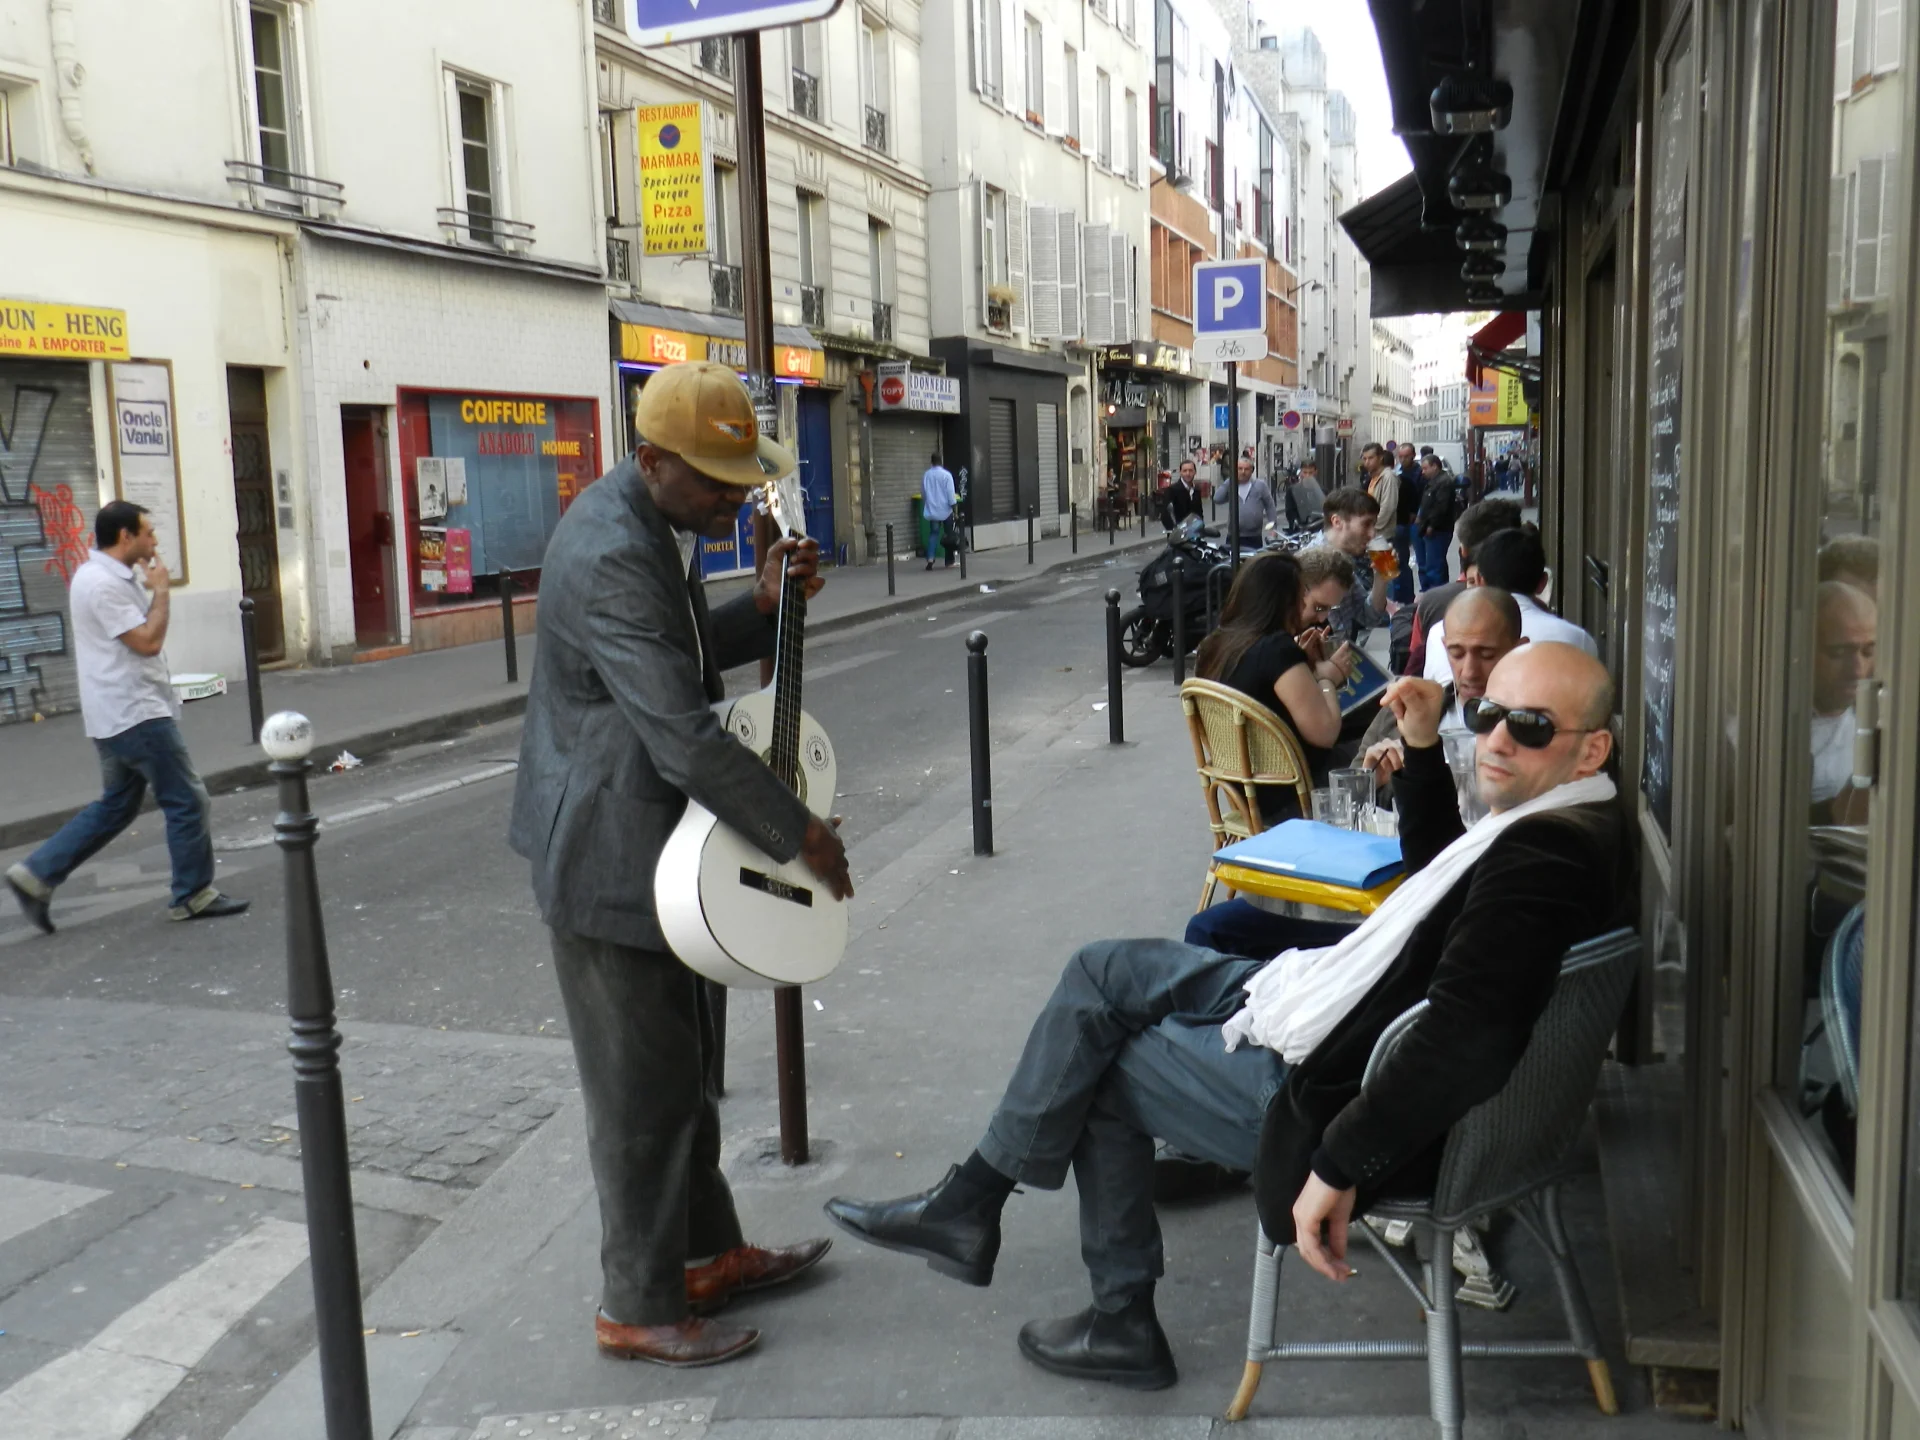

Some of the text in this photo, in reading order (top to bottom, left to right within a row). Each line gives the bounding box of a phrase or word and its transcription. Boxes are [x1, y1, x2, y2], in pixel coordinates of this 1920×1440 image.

[640, 104, 698, 122] RESTAURANT
[640, 152, 700, 170] MARMARA
[655, 189, 689, 202] turque
[653, 204, 692, 218] Pizza
[645, 222, 704, 236] Grillade au
[667, 238, 679, 250] de
[683, 236, 704, 249] bois
[1214, 276, 1244, 322] P
[66, 313, 123, 338] HENG
[28, 337, 37, 349] A
[42, 337, 106, 353] EMPORTER
[653, 334, 687, 362] Pizza
[786, 348, 812, 375] Grill
[881, 387, 904, 396] TOPY
[122, 410, 163, 428] Oncle
[461, 399, 547, 425] COIFFURE
[125, 427, 165, 446] Vania
[478, 431, 535, 455] ANADOLU
[542, 440, 581, 456] HOMME
[704, 540, 734, 554] PORTER
